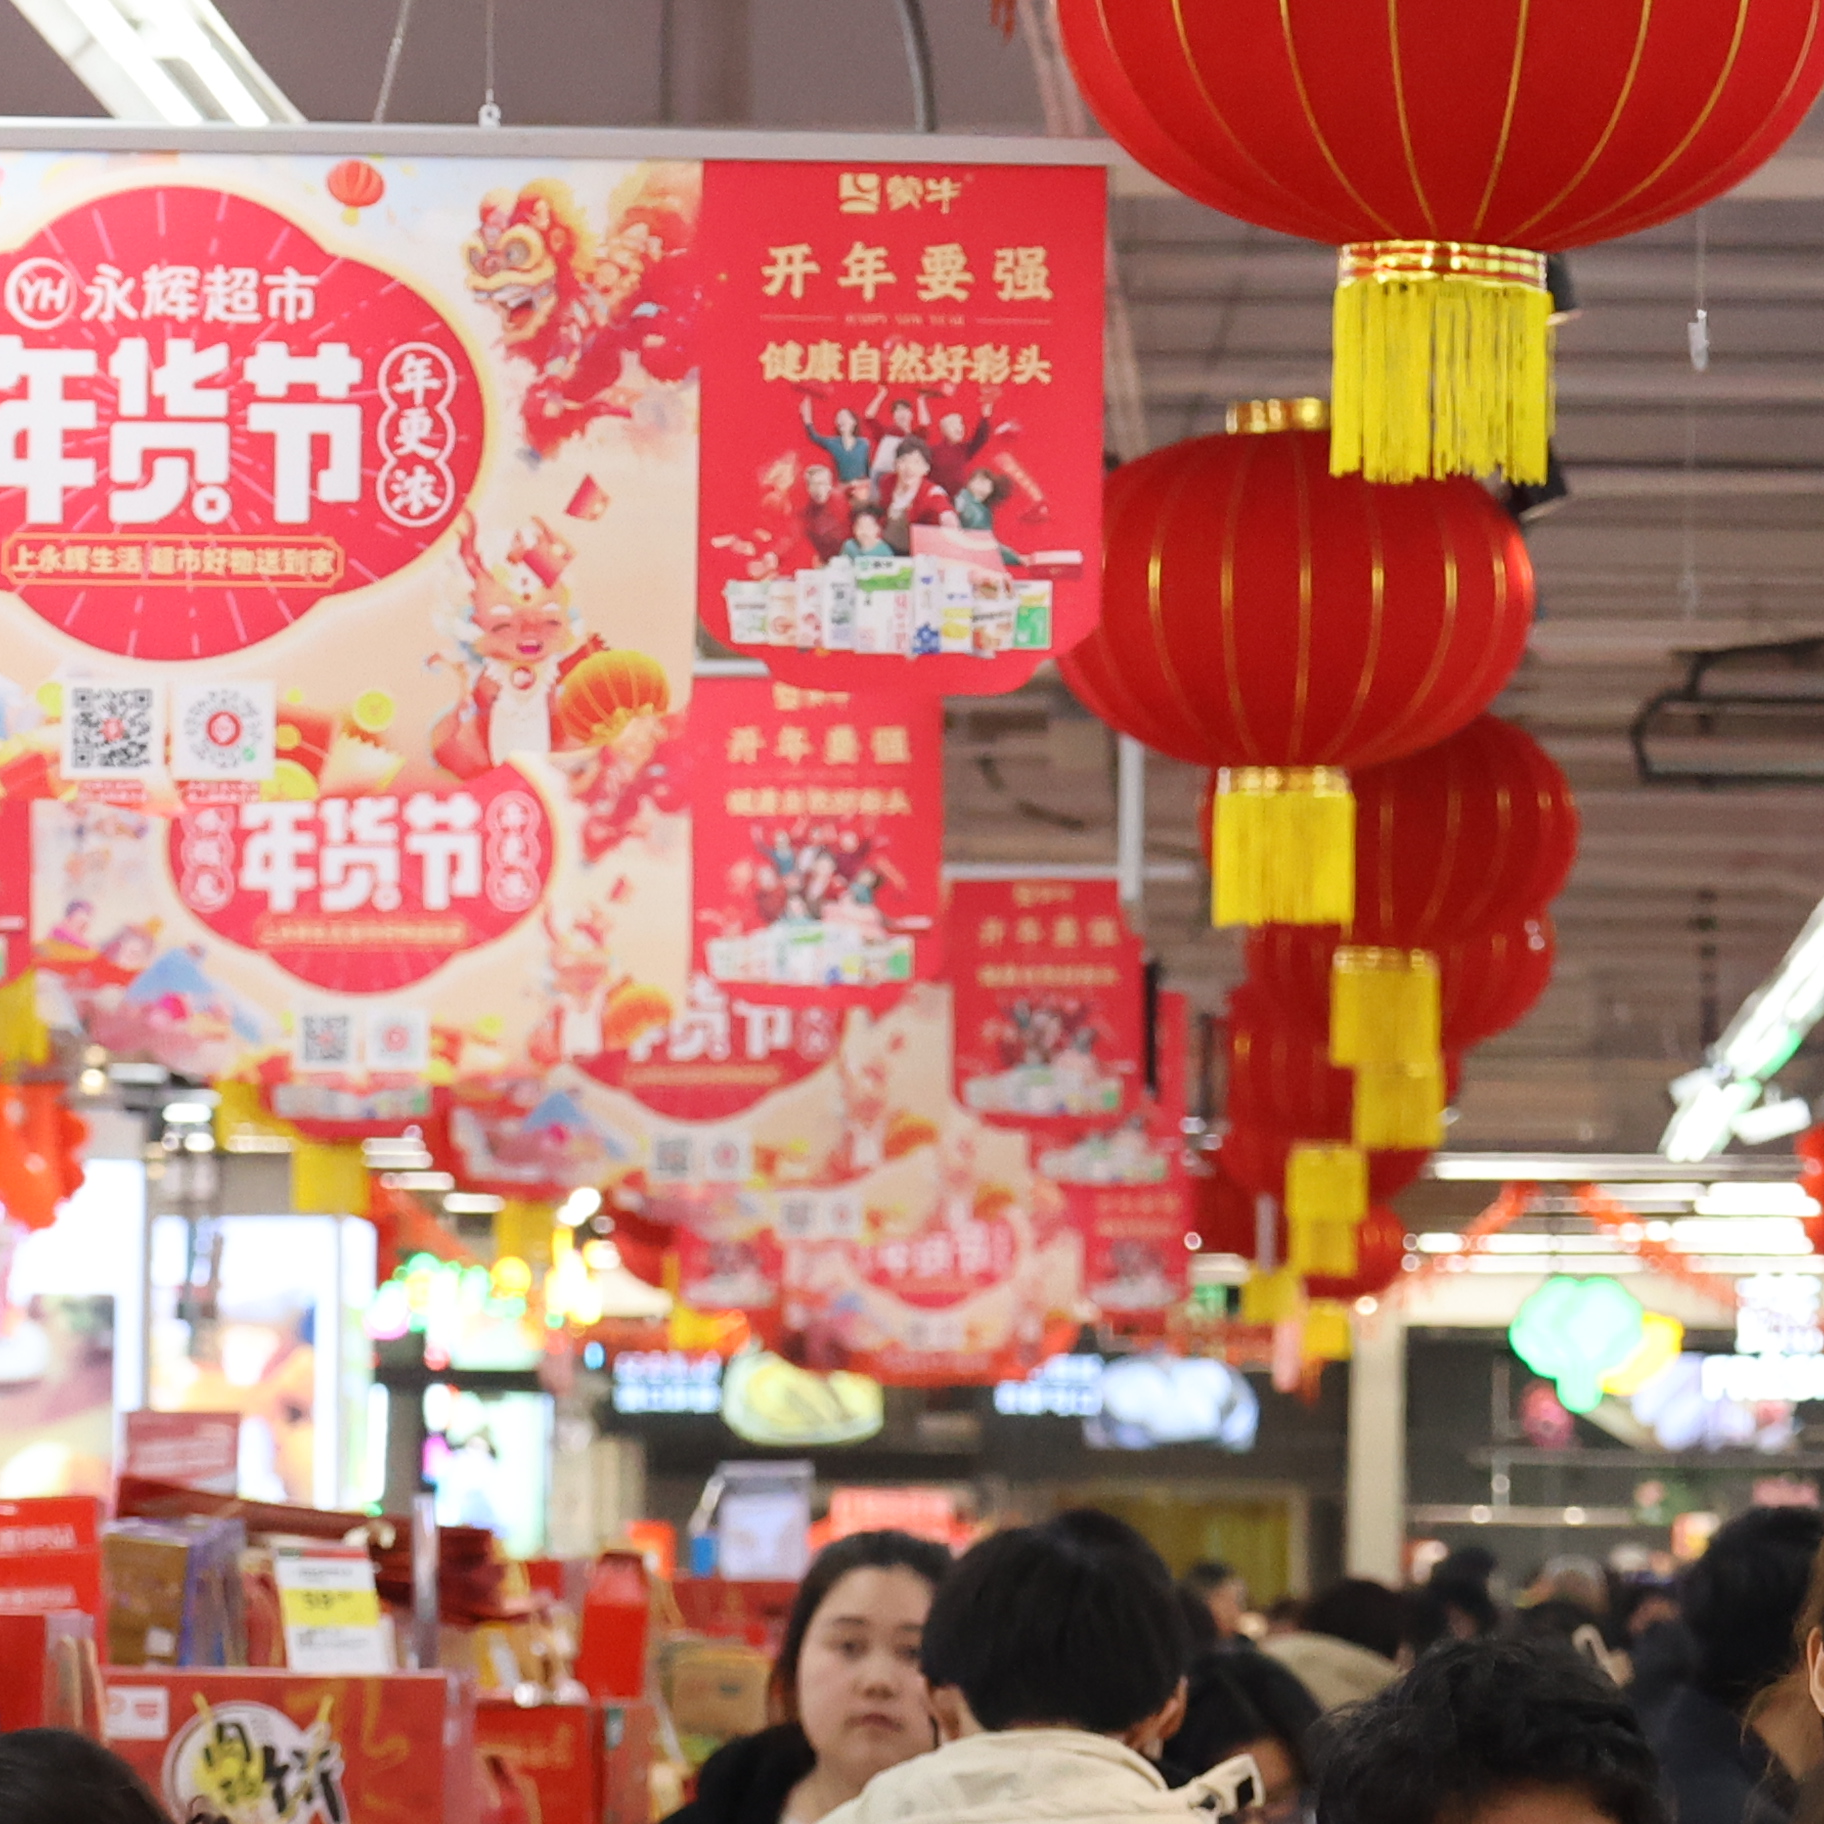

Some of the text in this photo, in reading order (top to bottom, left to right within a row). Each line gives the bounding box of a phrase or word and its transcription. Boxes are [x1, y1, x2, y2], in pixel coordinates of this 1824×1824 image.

[887, 175, 961, 213] 蒙牛
[82, 264, 318, 324] 永辉超市
[760, 242, 1053, 301] 开年要强
[758, 340, 1052, 385] 健康自然好彩头
[393, 354, 441, 513] 年更浓
[238, 793, 482, 913] 年货节
